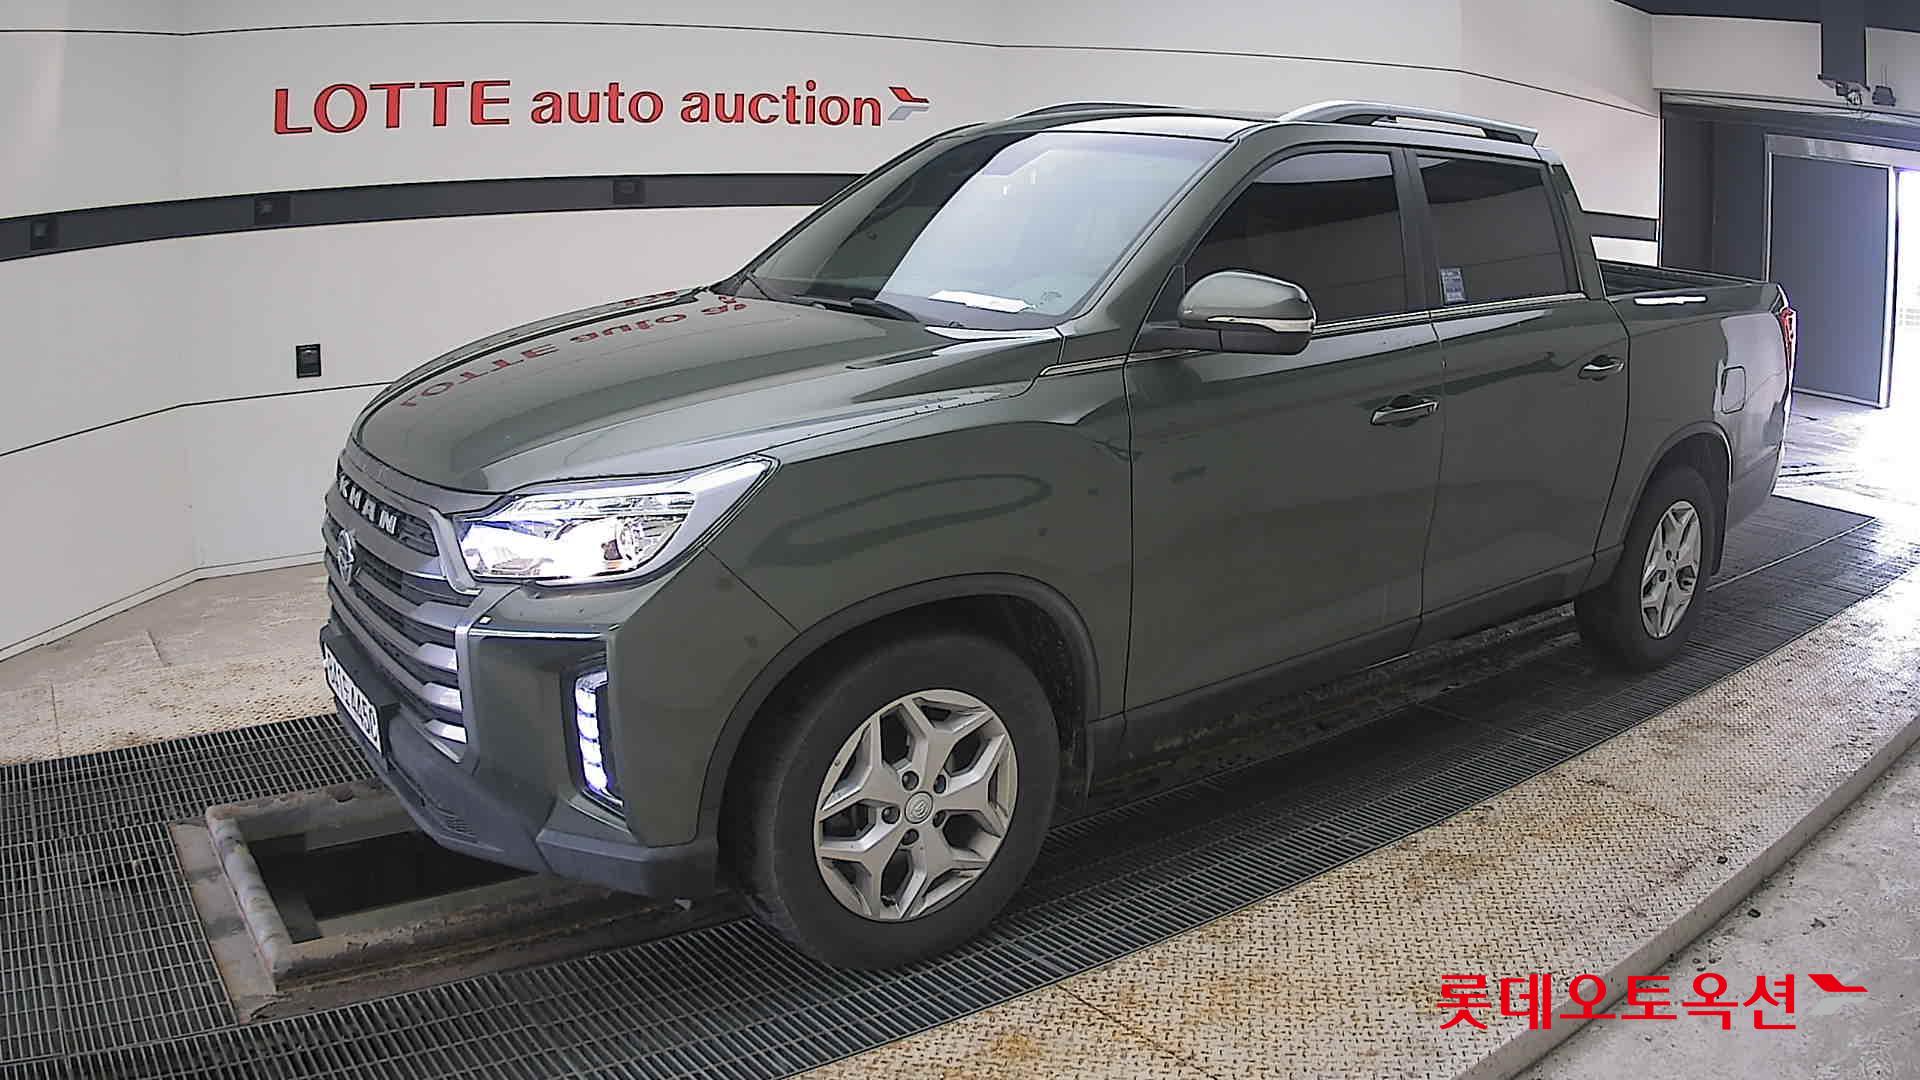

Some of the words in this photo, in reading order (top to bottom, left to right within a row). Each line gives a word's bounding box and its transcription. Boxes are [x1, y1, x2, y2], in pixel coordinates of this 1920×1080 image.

[274, 80, 511, 135] LOTTE
[530, 82, 665, 125] auto
[679, 79, 883, 127] auction
[339, 475, 397, 535] KHAN
